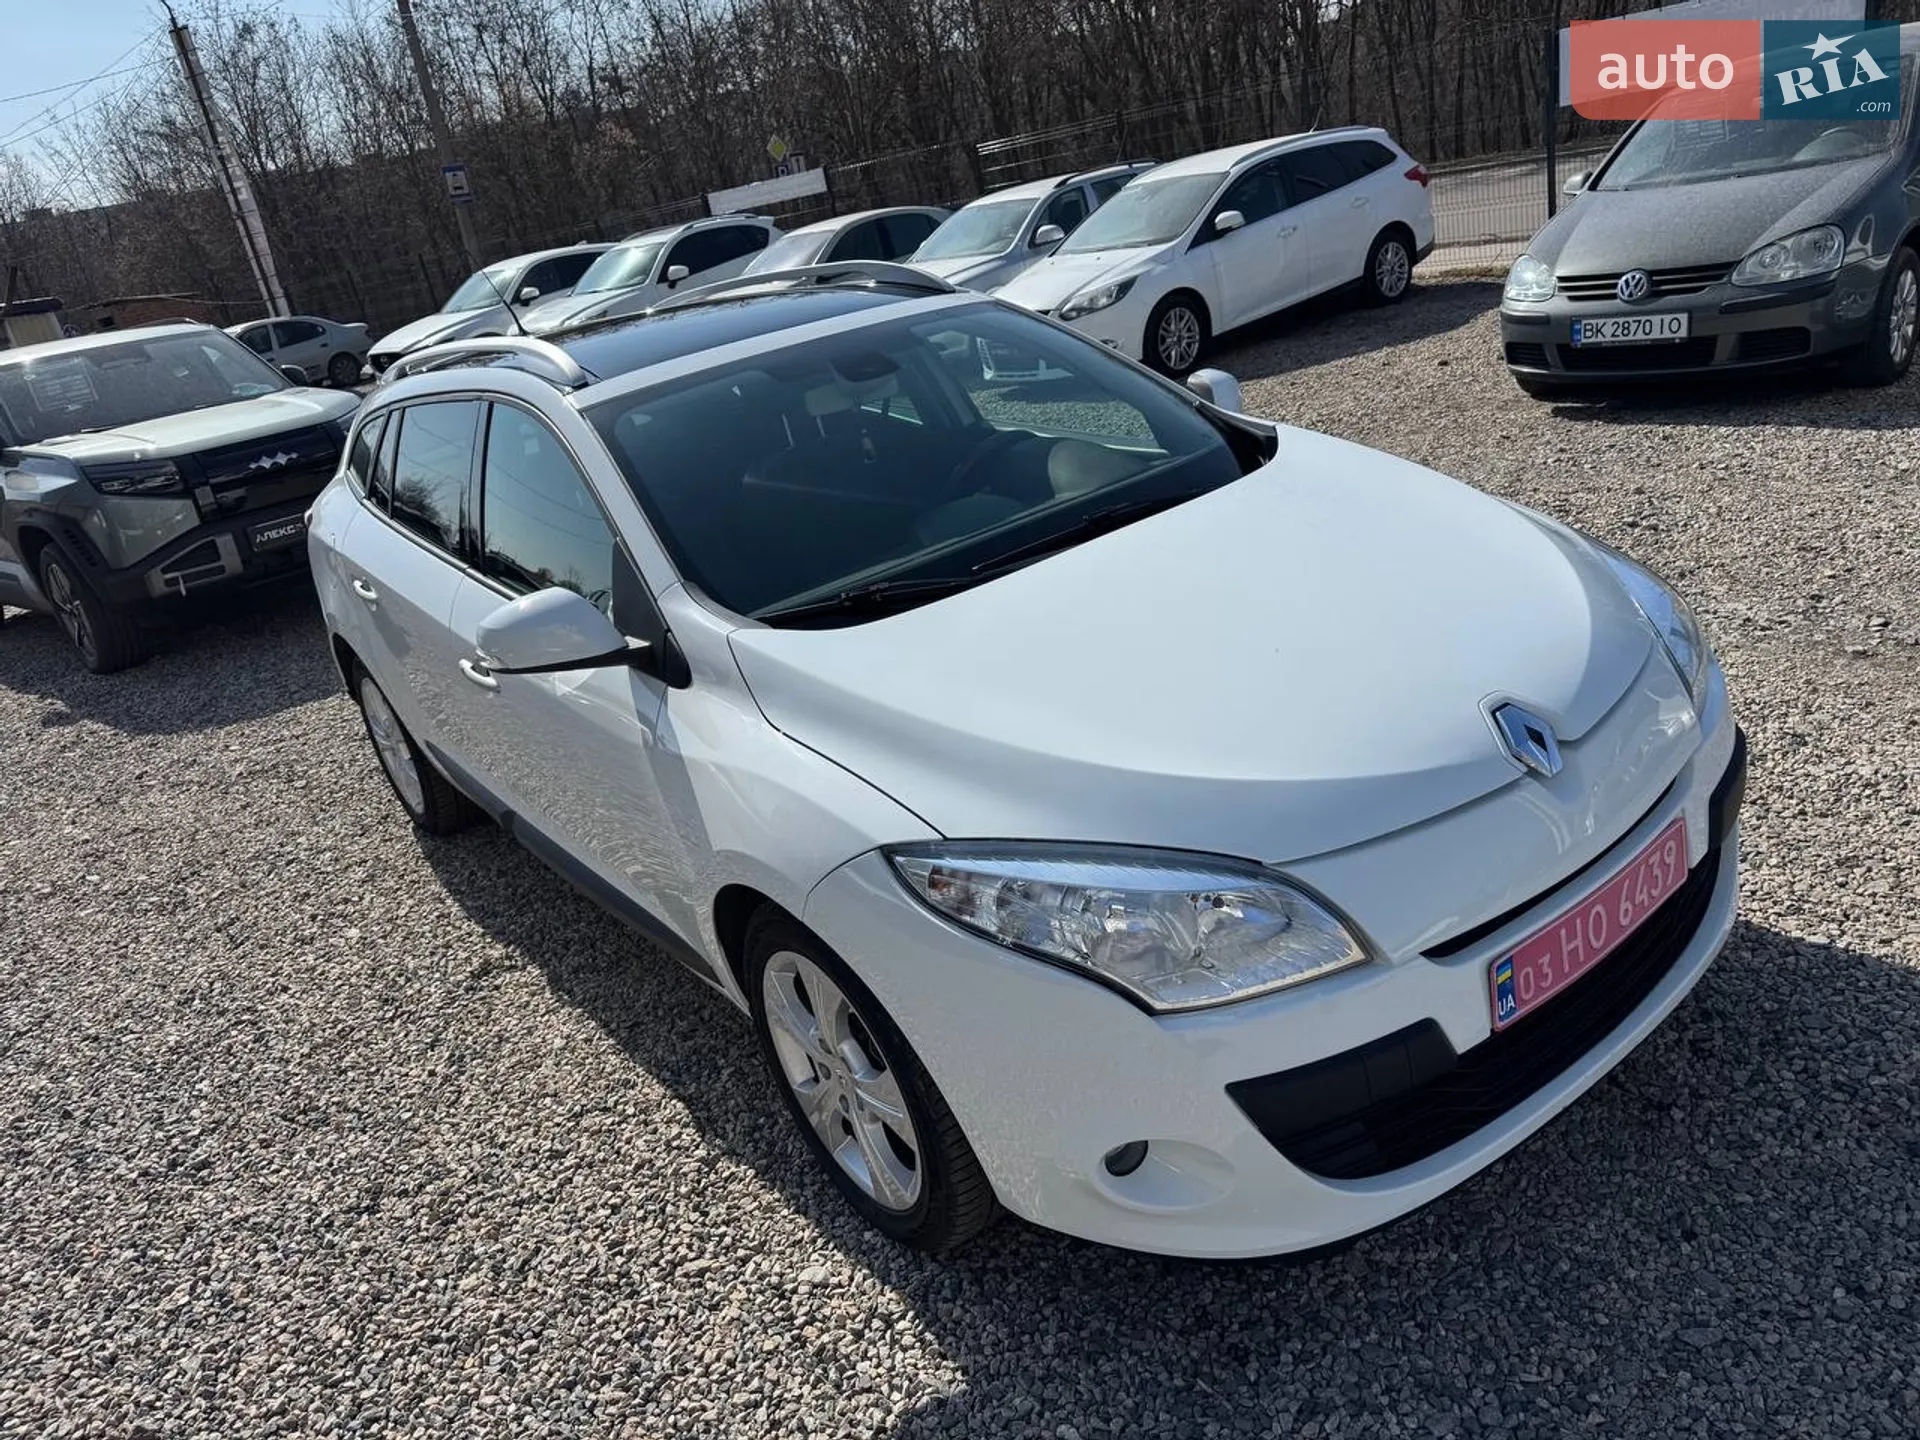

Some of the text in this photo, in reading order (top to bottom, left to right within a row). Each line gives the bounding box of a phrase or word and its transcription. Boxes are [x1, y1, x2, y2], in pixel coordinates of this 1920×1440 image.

[1583, 322, 1606, 339] BK
[1610, 319, 1653, 337] 2870
[1519, 840, 1676, 1000] 03 HO 6439
[1498, 994, 1515, 1016] UA
